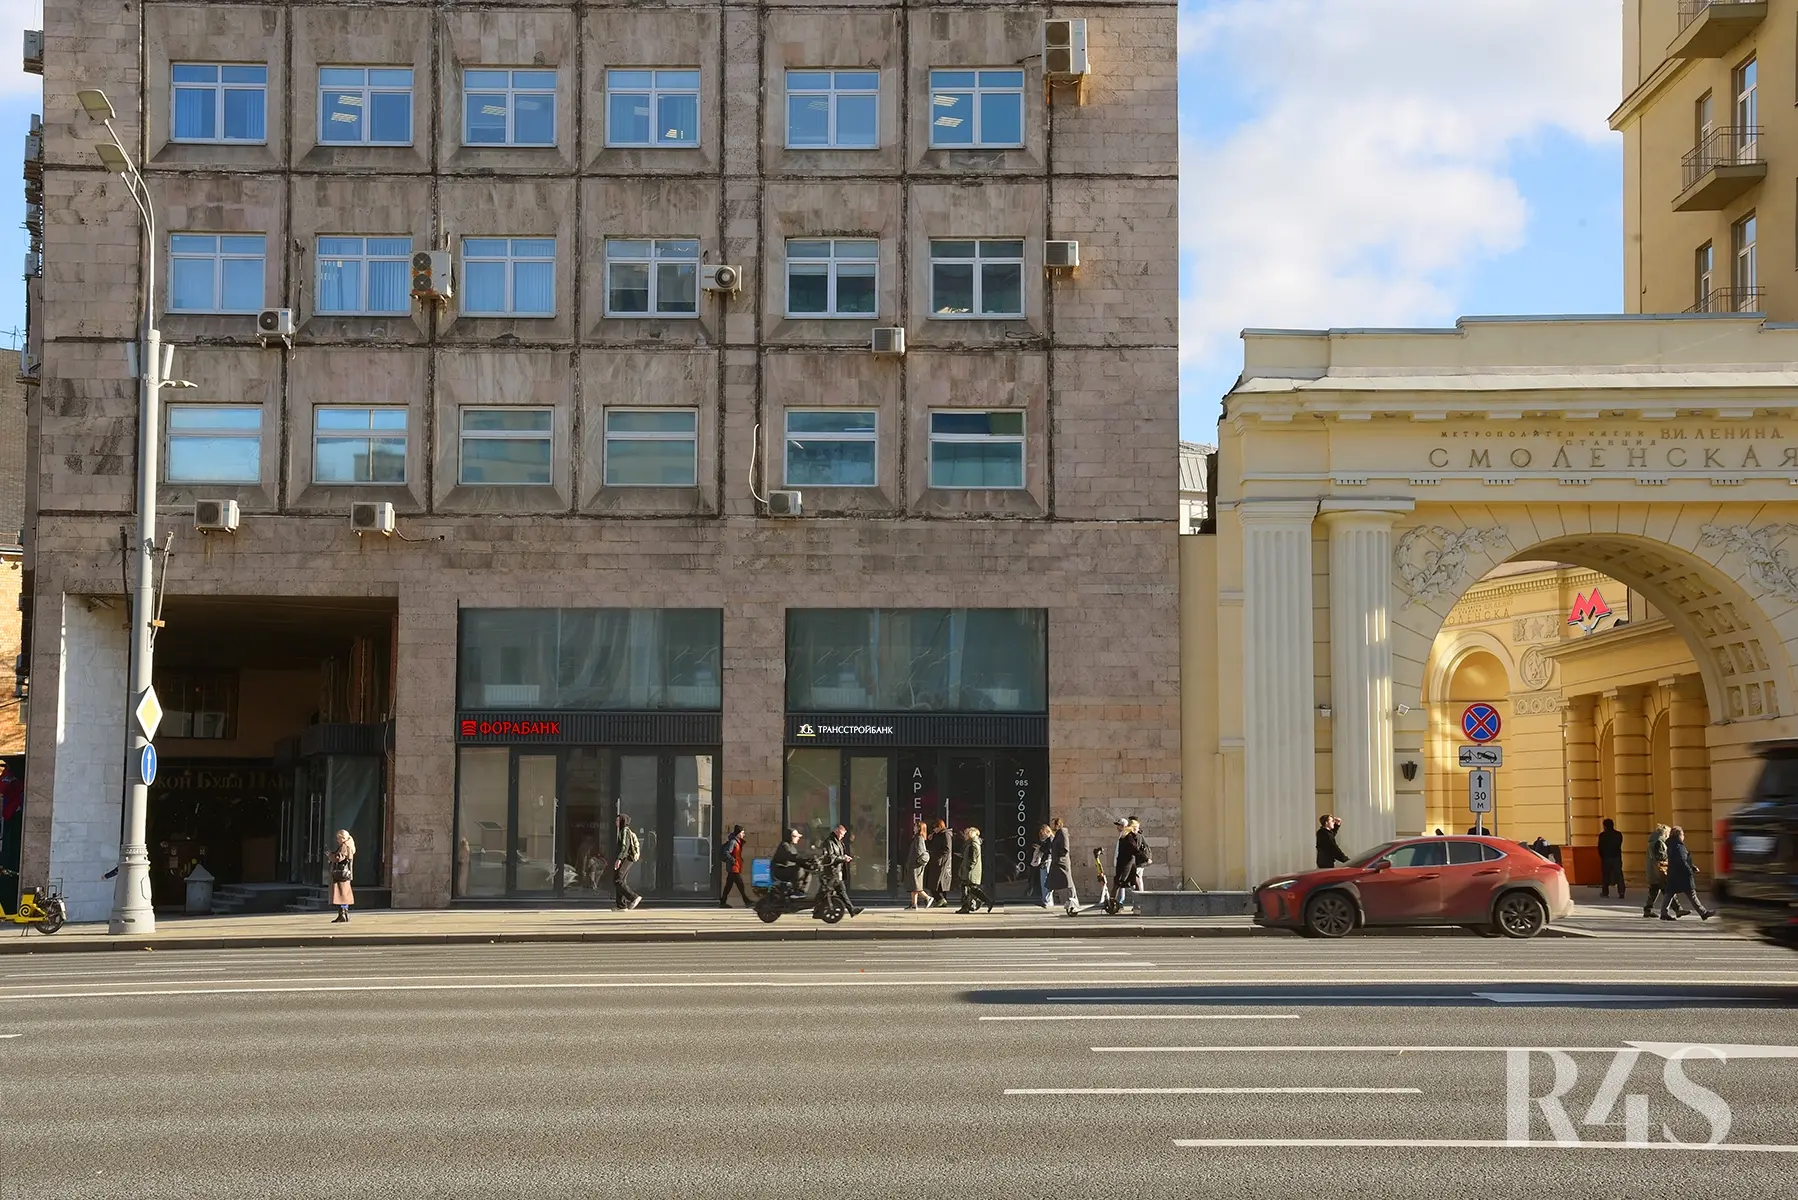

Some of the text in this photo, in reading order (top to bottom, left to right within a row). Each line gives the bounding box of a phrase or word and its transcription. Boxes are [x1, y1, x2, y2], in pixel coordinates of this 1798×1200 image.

[1428, 445, 1798, 468] СМОЛЕНСКАЯ
[1447, 608, 1510, 625] ОЛЕНСКА
[479, 721, 560, 735] ФОРАБАНК
[817, 725, 893, 734] ТРАНССТРОЙБАНК
[1014, 779, 1029, 787] 985
[912, 767, 923, 824] АРЕН
[1474, 791, 1487, 800] 30
